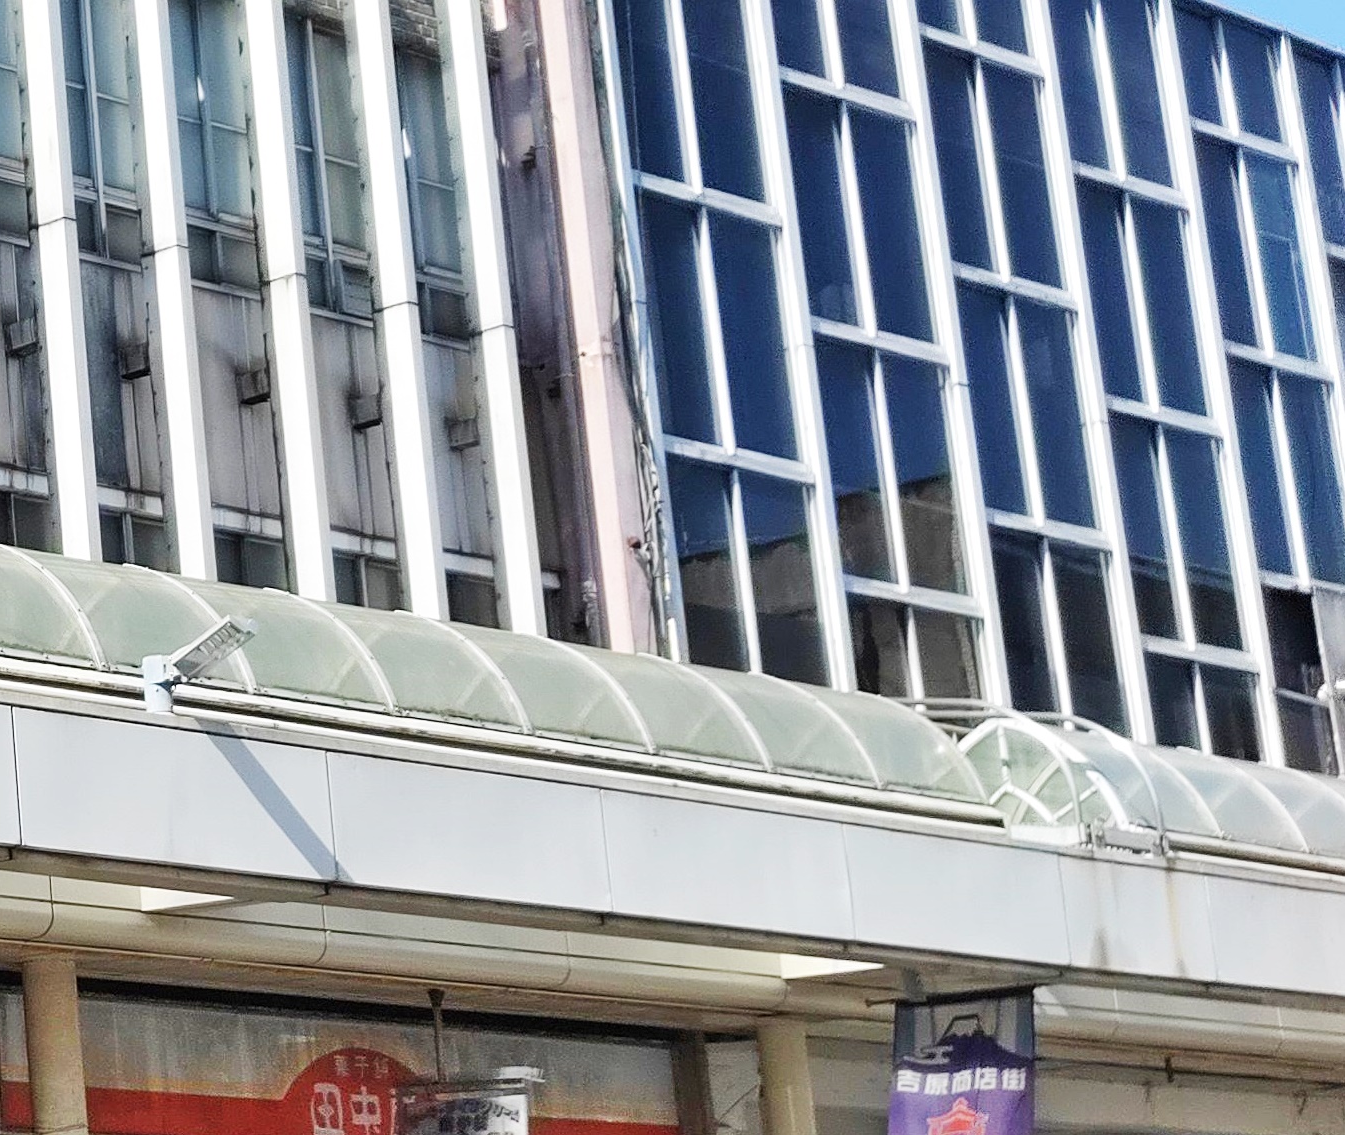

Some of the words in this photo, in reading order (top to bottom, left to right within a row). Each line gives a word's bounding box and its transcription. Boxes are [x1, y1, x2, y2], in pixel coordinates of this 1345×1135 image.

[896, 1067, 1027, 1095] 吉原商店街
